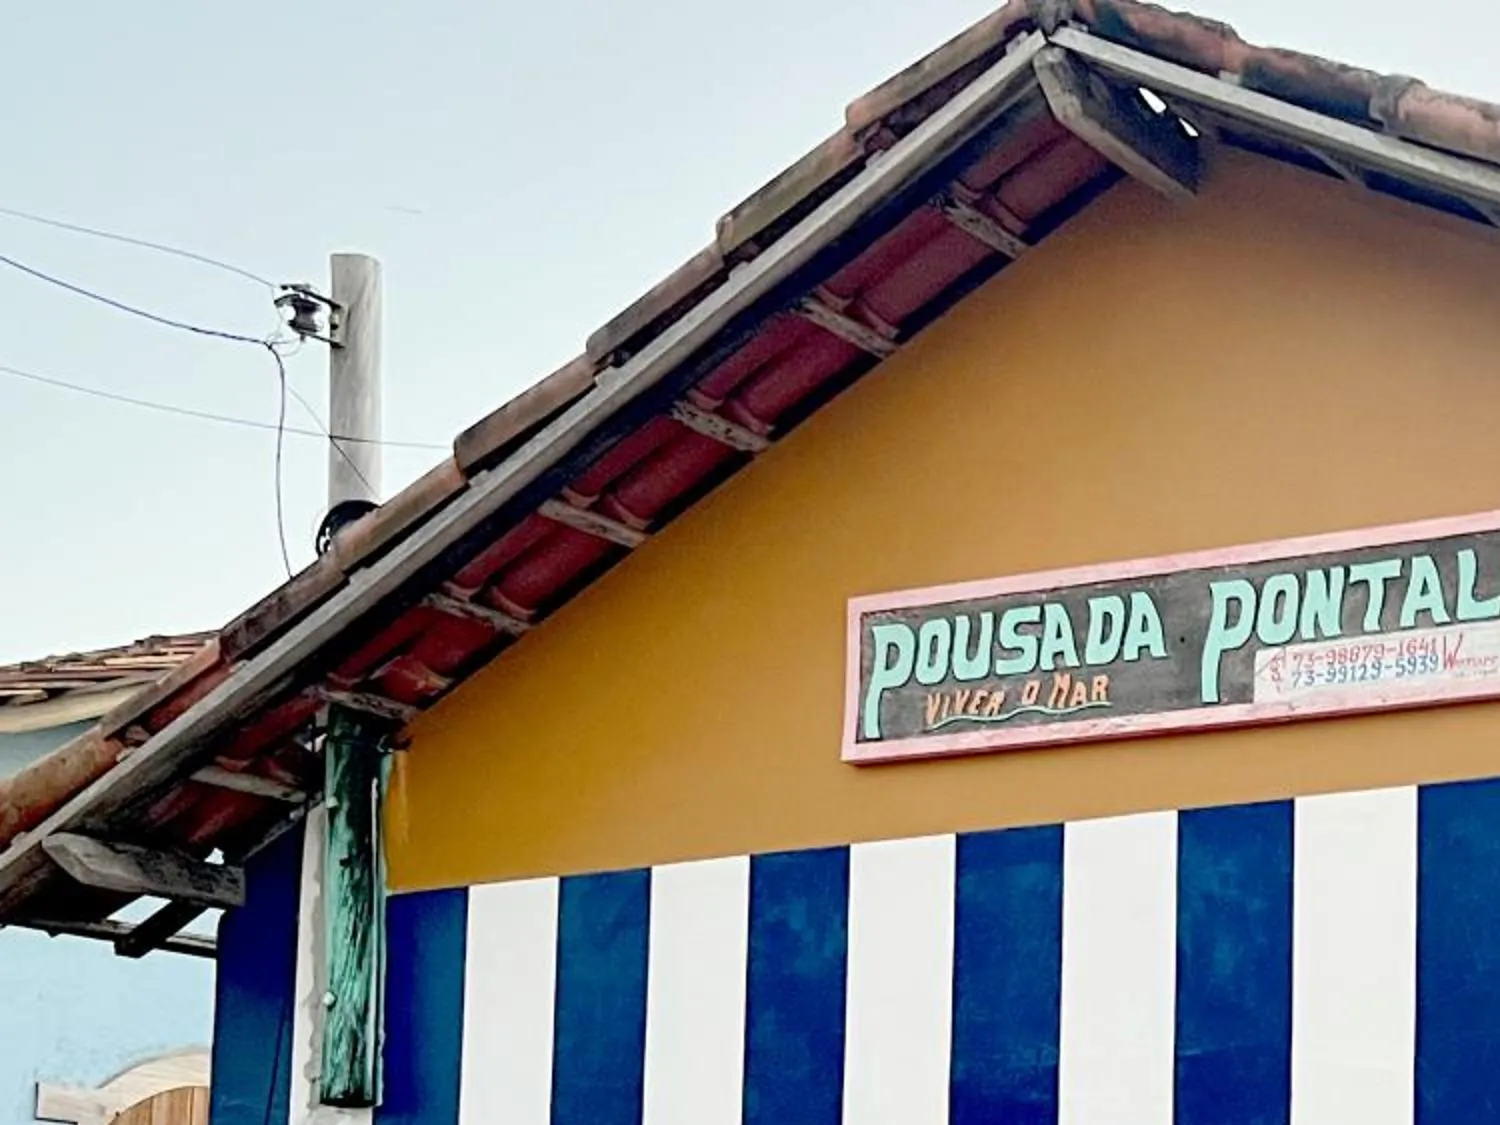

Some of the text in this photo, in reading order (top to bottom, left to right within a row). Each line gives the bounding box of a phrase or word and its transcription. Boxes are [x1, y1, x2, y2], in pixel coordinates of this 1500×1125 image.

[863, 591, 1168, 739] POUSADA
[1021, 679, 1042, 706] O
[1048, 671, 1110, 709] MAR
